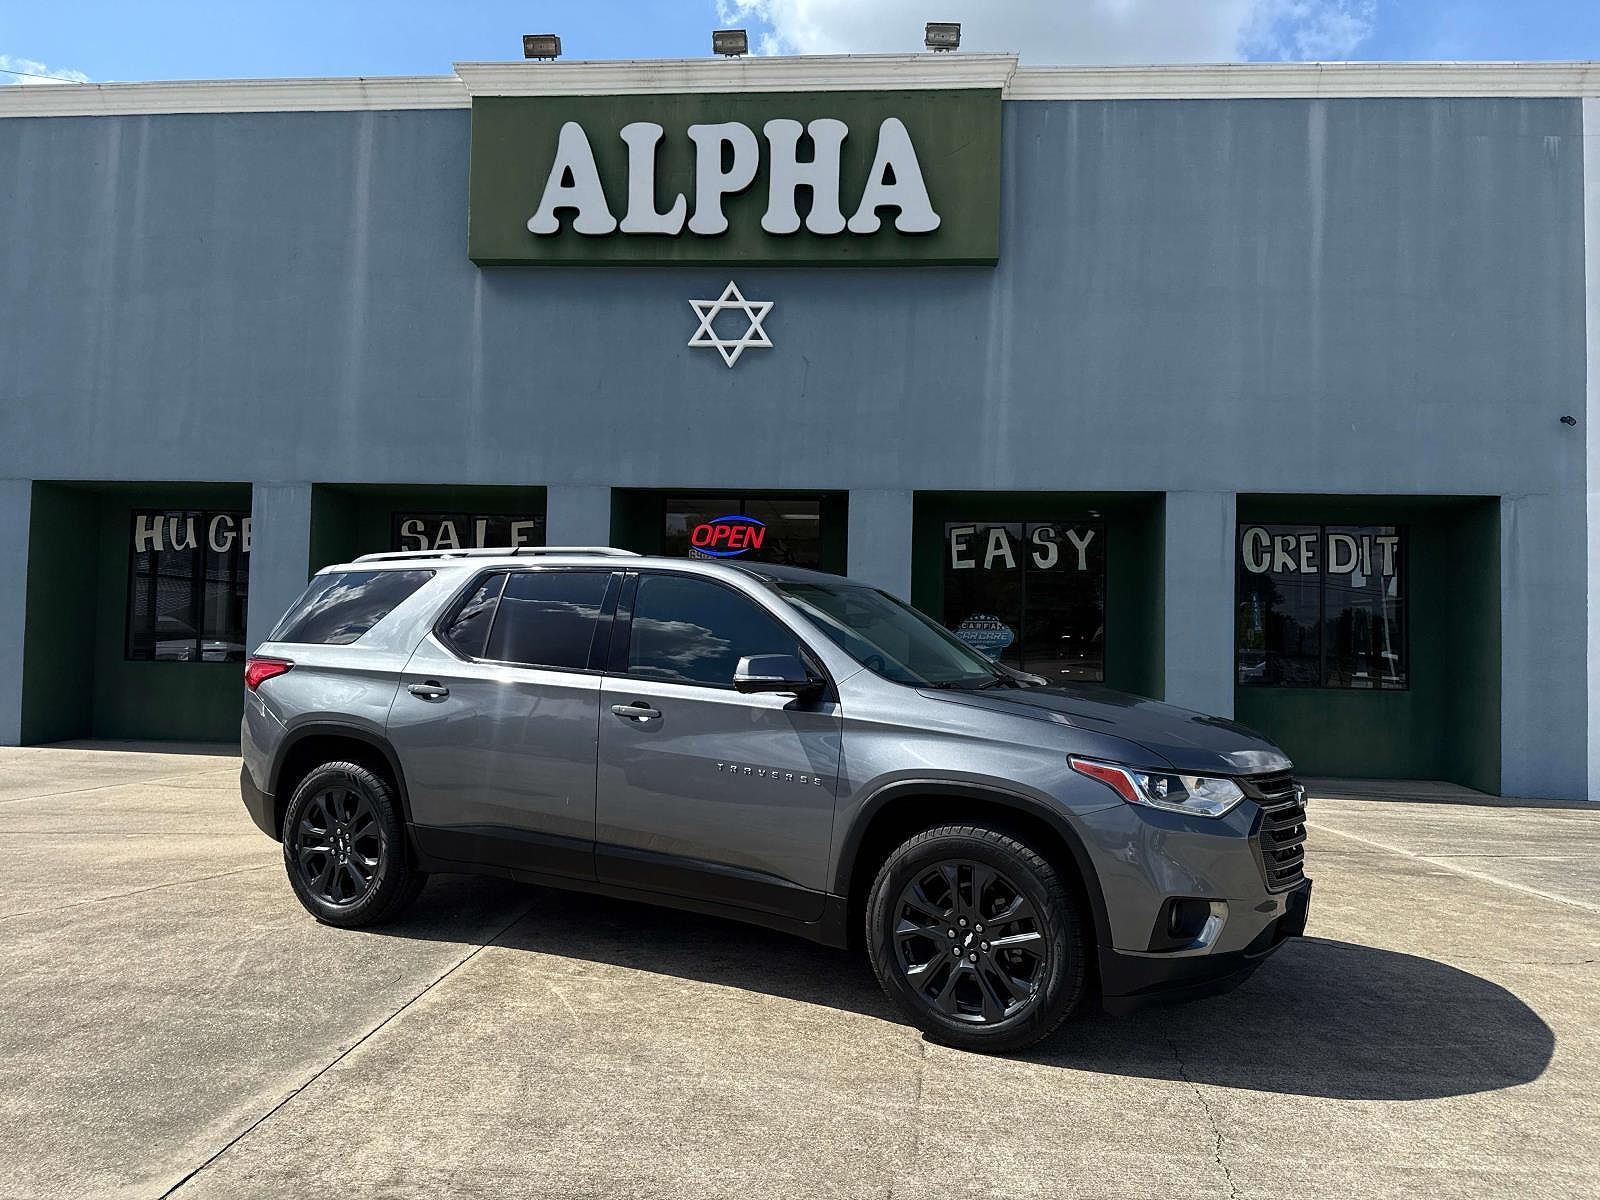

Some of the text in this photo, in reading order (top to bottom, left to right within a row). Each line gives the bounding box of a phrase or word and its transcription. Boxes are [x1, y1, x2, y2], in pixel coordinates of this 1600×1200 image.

[527, 117, 941, 235] ALPHA
[691, 524, 766, 549] OPEN
[951, 526, 1096, 571] EASY
[1242, 527, 1399, 576] CREDIT
[978, 631, 1009, 640] CARE
[717, 763, 822, 786] TRAVERSE
